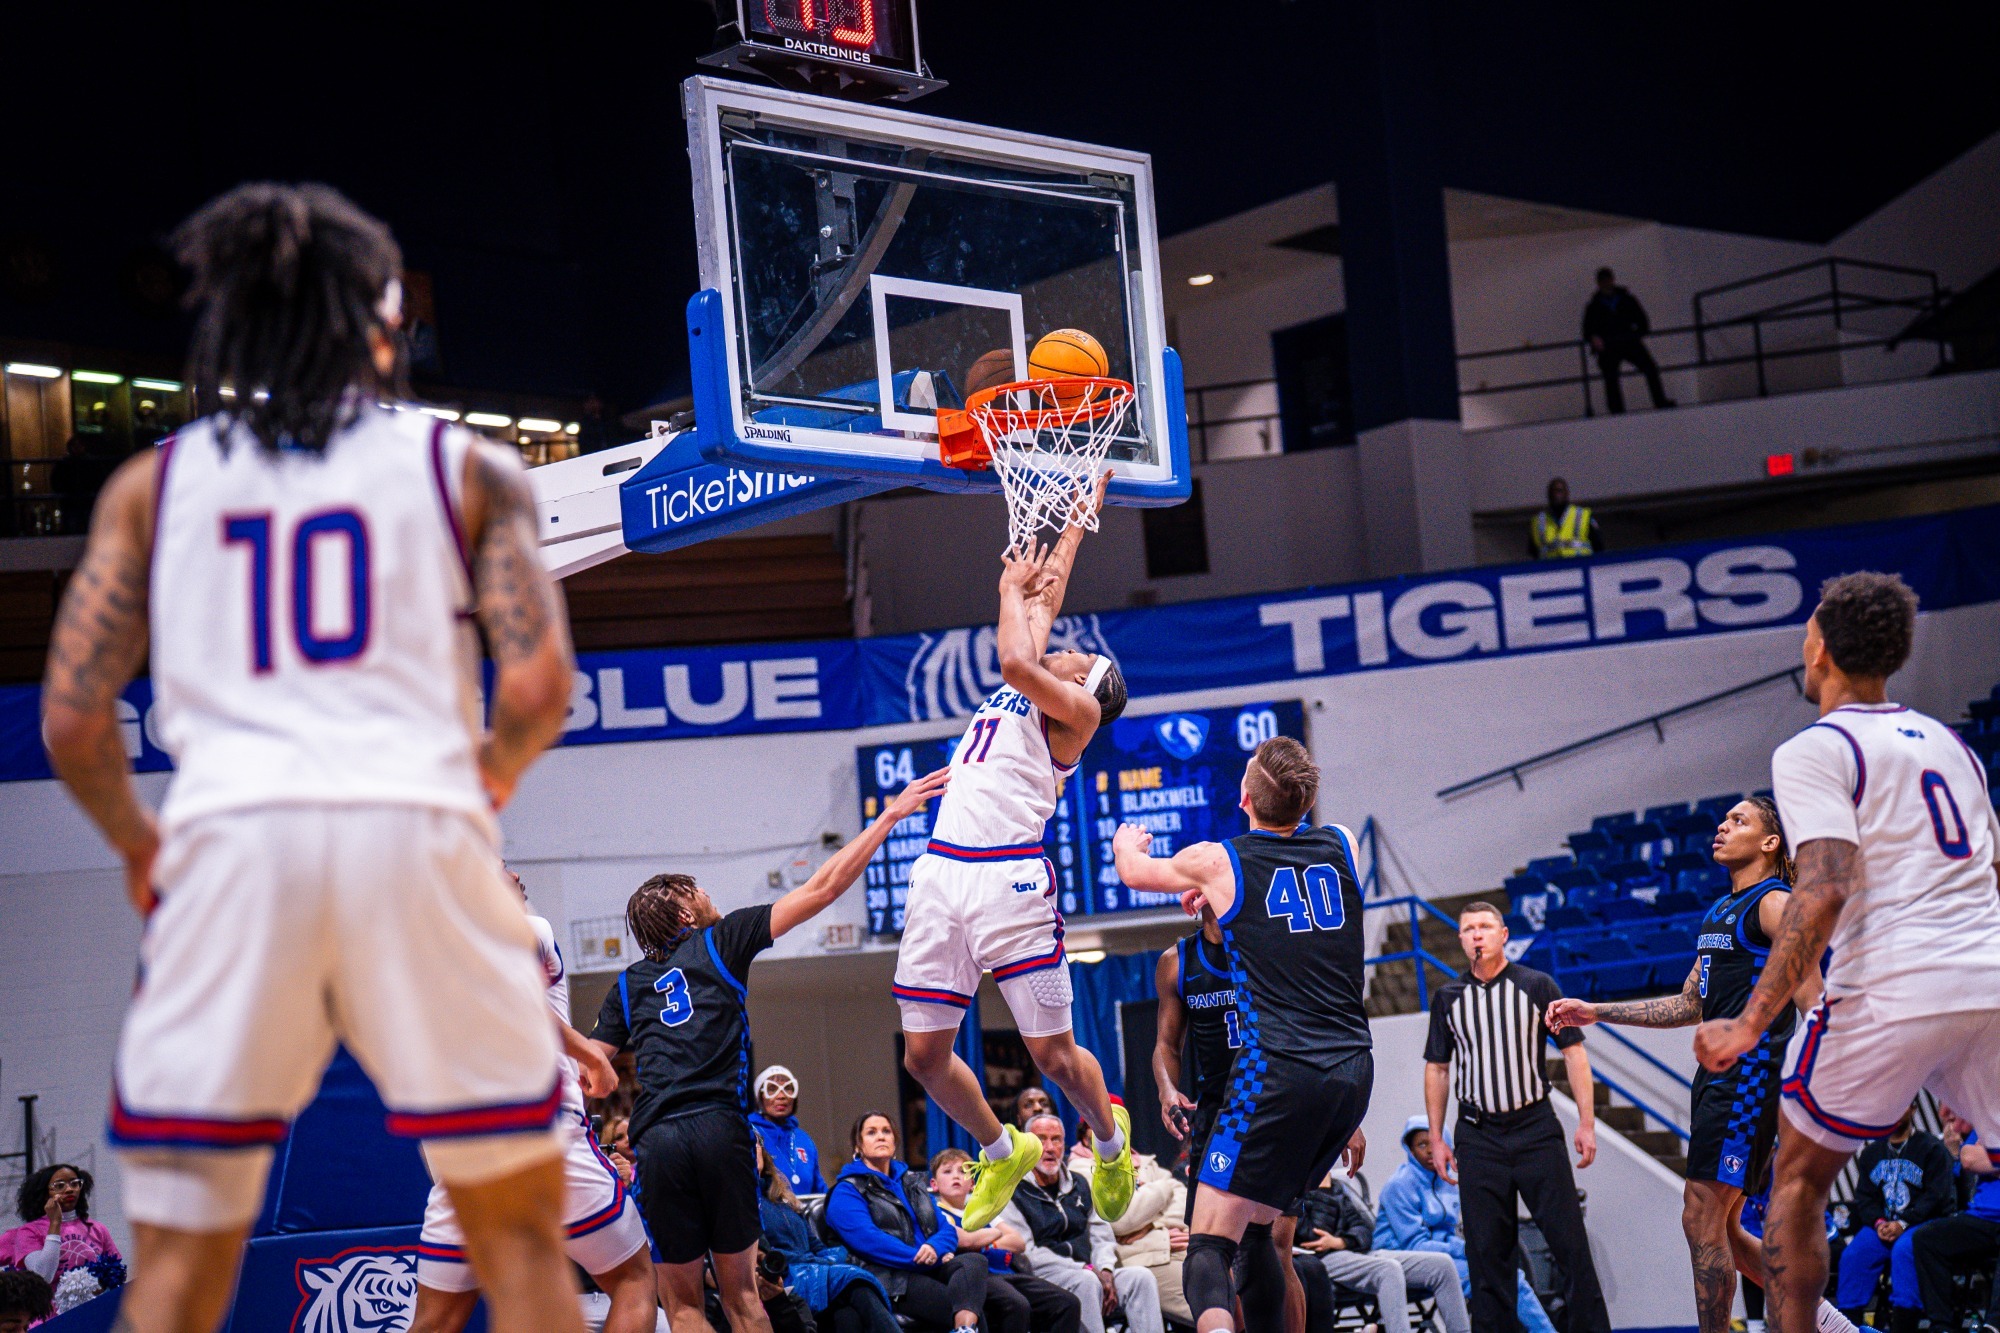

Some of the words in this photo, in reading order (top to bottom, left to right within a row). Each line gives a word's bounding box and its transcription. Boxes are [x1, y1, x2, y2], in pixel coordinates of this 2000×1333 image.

[784, 37, 871, 64] DAKTRONICS
[744, 425, 793, 443] SPALDING
[221, 507, 371, 675] 10
[1259, 545, 1802, 673] TIGERS
[962, 716, 1001, 765] 11
[1237, 711, 1278, 751] 60
[875, 748, 916, 789] 64
[1118, 767, 1162, 791] NAME
[1056, 799, 1069, 818] 4
[1099, 793, 1110, 815] 1
[1121, 786, 1208, 813] BLACKWELL
[1921, 769, 1973, 860] 0
[1057, 822, 1071, 843] 2
[1097, 817, 1117, 840] 10
[867, 864, 886, 887] 11
[1012, 882, 1037, 893] tsu
[1063, 869, 1075, 890] 1
[1265, 863, 1346, 933] 40
[871, 909, 885, 932] 7
[1699, 954, 1711, 999] 5
[654, 967, 694, 1028] 3
[1224, 1010, 1242, 1049] 1
